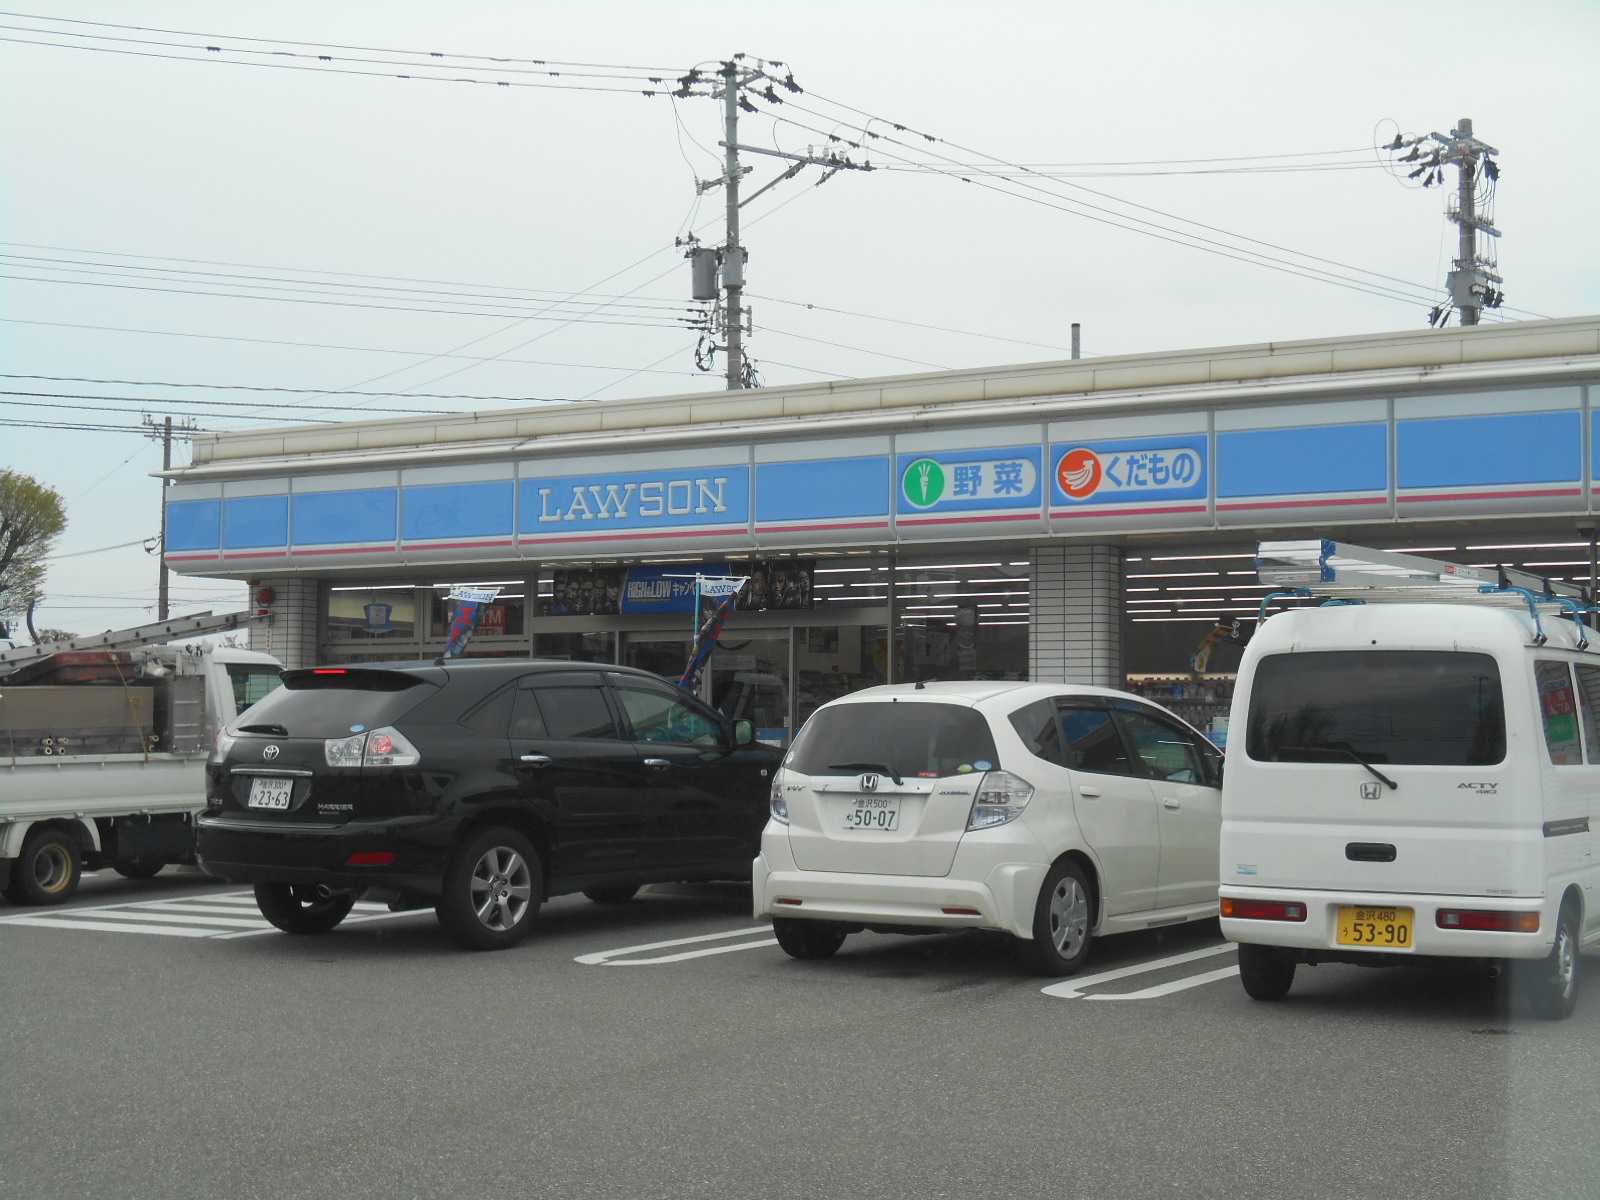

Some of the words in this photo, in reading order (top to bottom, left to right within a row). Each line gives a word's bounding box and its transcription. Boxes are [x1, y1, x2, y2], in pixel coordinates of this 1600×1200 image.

[953, 462, 1023, 497] 野菜
[1105, 452, 1195, 488] くだもの
[538, 477, 727, 522] LAWSON
[258, 790, 289, 807] 23-63
[857, 799, 888, 809] 金沢500
[854, 809, 896, 827] 50-07
[1355, 910, 1396, 922] 金沢480
[1352, 922, 1408, 944] 53-90
